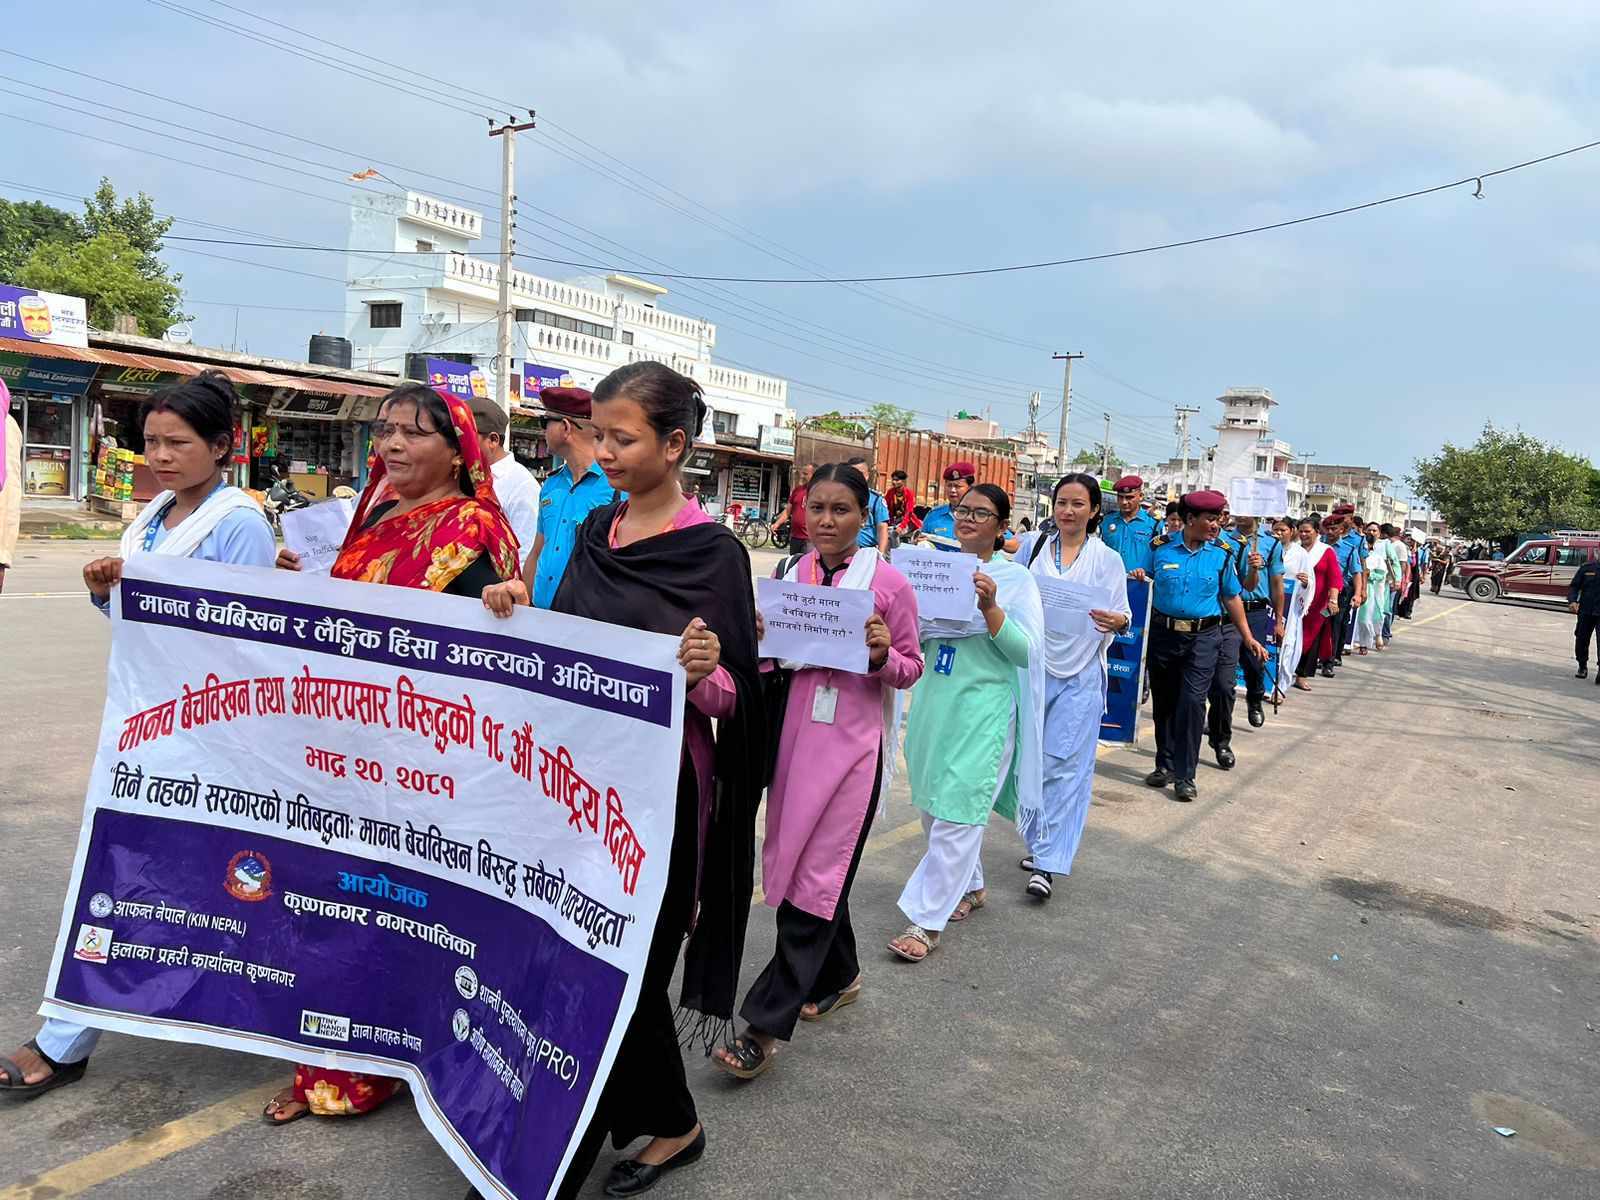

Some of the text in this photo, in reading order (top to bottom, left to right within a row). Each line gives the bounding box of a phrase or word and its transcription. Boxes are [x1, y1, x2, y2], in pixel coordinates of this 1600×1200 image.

[195, 598, 288, 634] बेचबिखन
[293, 617, 309, 638] र
[314, 616, 382, 656] लैङ्गिक
[388, 627, 439, 660] हिंसा
[445, 643, 545, 681] अन्त्यको
[804, 623, 829, 635] निर्माण
[118, 698, 177, 752] मानव
[254, 677, 286, 716] तथा
[291, 664, 392, 729] ओसारपसार
[482, 715, 504, 762] १८
[603, 786, 646, 896] दिवस
[305, 746, 347, 778] भाद्र
[396, 766, 455, 800] २०८१
[147, 773, 202, 808] तहको
[204, 784, 282, 824] सरकारको
[359, 817, 401, 852] मानव
[523, 859, 566, 910] सबैको
[337, 871, 429, 910] आयोजक
[113, 900, 247, 938] आफन्त नेपाल (KIN NEPAL)
[376, 910, 477, 960] नगरपालिका
[111, 941, 155, 961] इलाका
[158, 946, 189, 966] प्रहरी
[191, 950, 244, 976] कार्यालय
[320, 1017, 338, 1025] TINY
[320, 1023, 347, 1033] HANDS
[320, 1029, 345, 1039] NEPAL
[351, 1023, 373, 1040] साना
[401, 1027, 422, 1052] नेपाल
[532, 1037, 580, 1091] (PRC)
